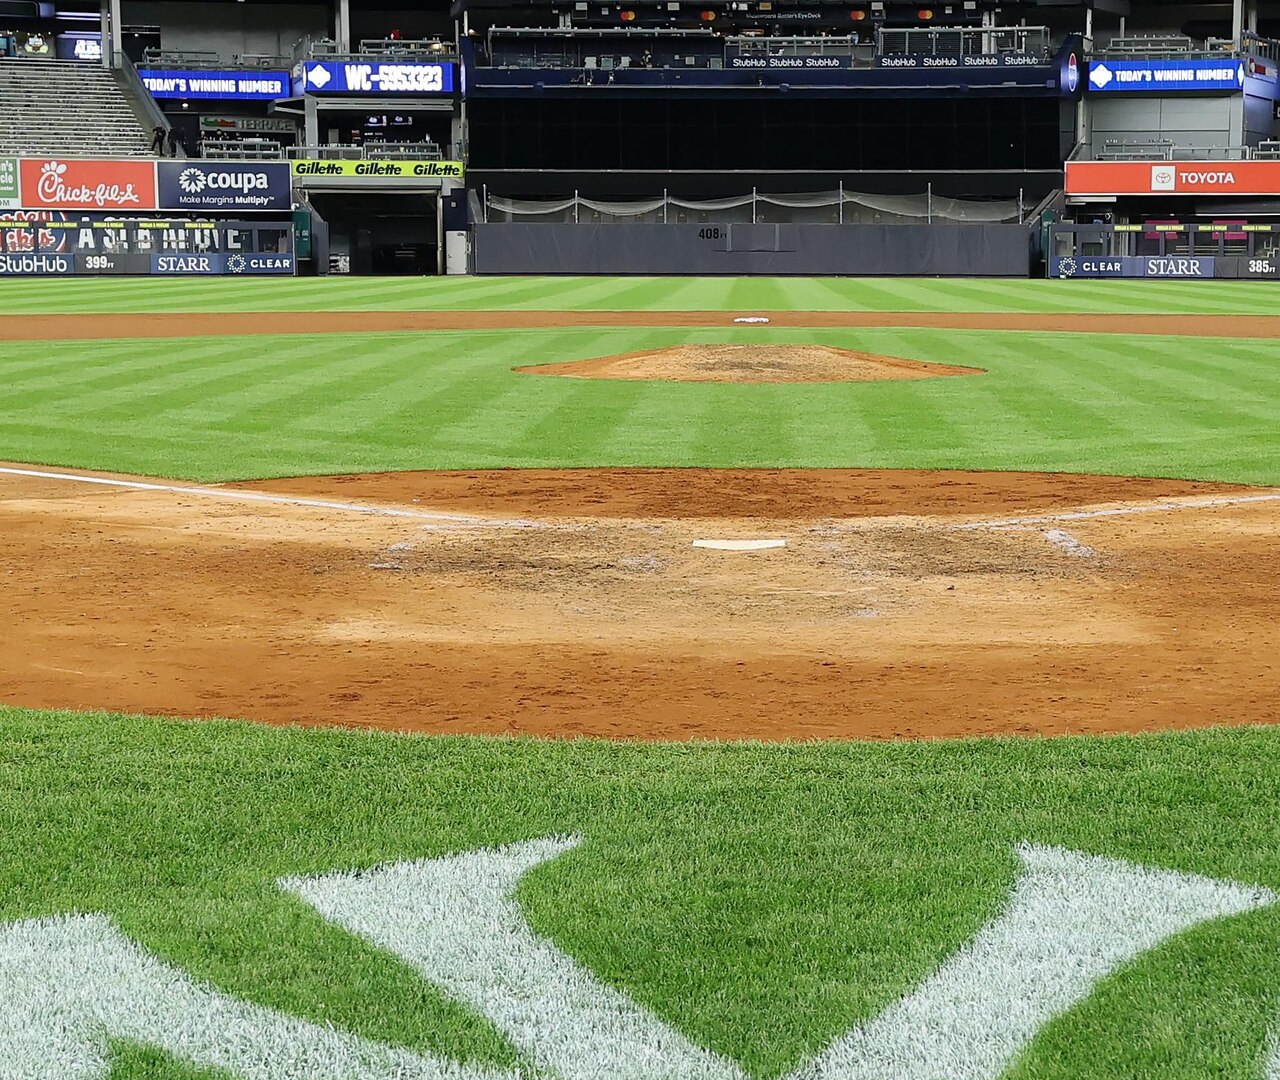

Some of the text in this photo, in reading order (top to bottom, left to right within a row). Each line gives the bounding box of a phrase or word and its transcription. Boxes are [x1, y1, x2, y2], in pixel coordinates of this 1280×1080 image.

[732, 58, 767, 67] StubHub
[769, 58, 803, 67] StubHub
[805, 58, 840, 67] StubHub
[881, 57, 917, 66] StubHub
[923, 57, 958, 66] StubHub
[964, 56, 998, 65] StubHub
[1004, 56, 1039, 65] StubHub
[1115, 69, 1234, 82] TODAY'S WINNING NUMBER
[143, 78, 282, 94] TODAY'S WINNING NUMBER
[295, 162, 343, 175] Gillette
[354, 162, 402, 175] Gillette
[413, 163, 460, 176] Gillette
[207, 171, 268, 193] coupa
[1180, 171, 1235, 185] TOYOTA
[179, 195, 201, 204] Make
[202, 195, 234, 207] Margins
[79, 217, 95, 249] A
[157, 257, 211, 271] STARR
[250, 259, 291, 268] CLEAR
[1082, 262, 1122, 271] CLEAR
[1148, 259, 1202, 275] STARR
